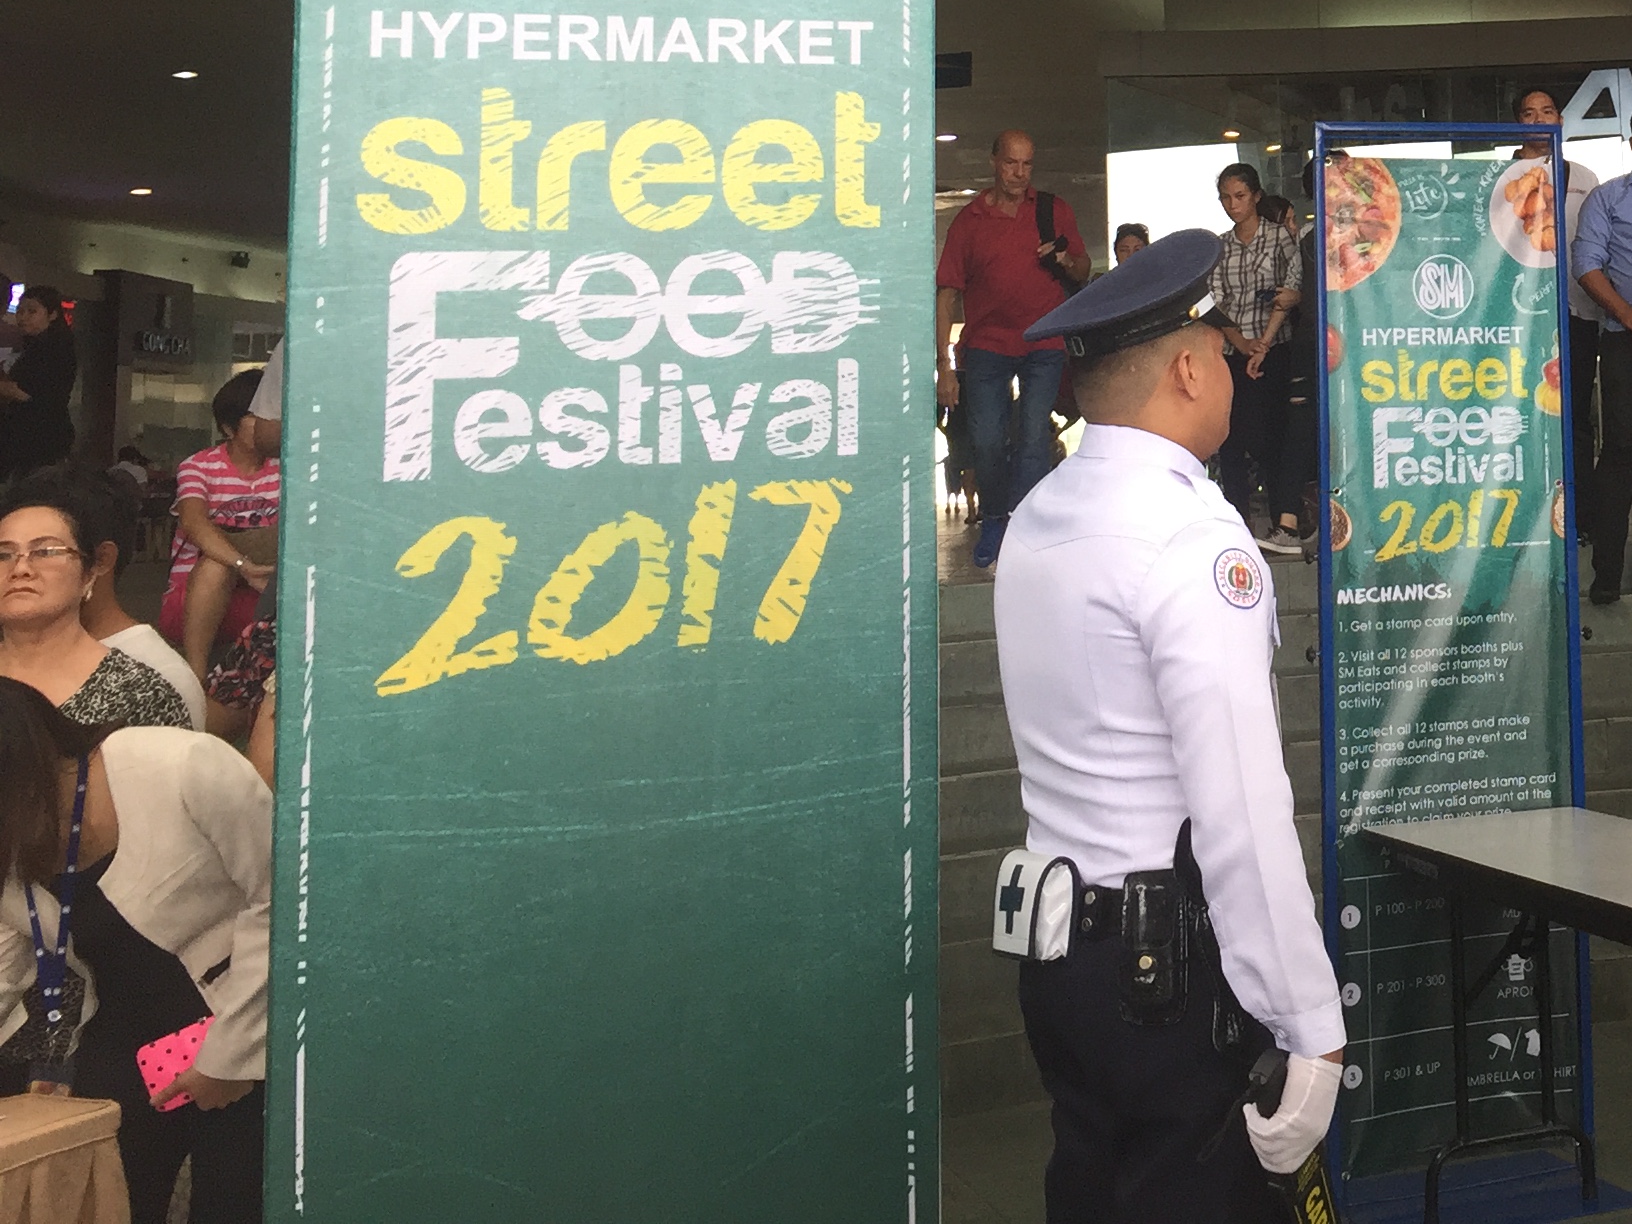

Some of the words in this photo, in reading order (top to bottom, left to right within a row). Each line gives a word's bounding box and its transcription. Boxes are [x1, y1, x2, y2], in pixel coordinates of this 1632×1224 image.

[369, 10, 874, 66] HYPERMARKET
[356, 87, 881, 233] street
[1419, 262, 1465, 311] SM
[1362, 326, 1524, 346] HYPERMARKET
[1361, 346, 1528, 403] street
[1374, 488, 1522, 563] 2017
[376, 476, 853, 697] 2017
[1338, 621, 1348, 633] 1.
[1350, 620, 1372, 632] Get
[1375, 622, 1384, 631] a
[1386, 617, 1421, 631] stamp
[1424, 615, 1453, 627] card
[1456, 614, 1483, 627] upon
[1351, 649, 1375, 662] Visit
[1377, 648, 1391, 661] all
[1394, 647, 1407, 659] 12
[1461, 641, 1498, 654] booths
[1501, 640, 1524, 653] plus
[1338, 666, 1355, 679] SM
[1357, 664, 1380, 677] Eats
[1383, 662, 1407, 675] and
[1409, 660, 1450, 673] collect
[1452, 657, 1491, 672] stamps
[1493, 656, 1508, 669] by
[1338, 679, 1414, 696] participating
[1416, 676, 1428, 688] in
[1431, 674, 1459, 687] each
[1461, 671, 1505, 685] booth's
[1352, 725, 1393, 739] Collect
[1397, 722, 1412, 735] all
[1415, 722, 1427, 734] 12
[1428, 719, 1469, 733] stamps
[1471, 716, 1495, 728] and
[1497, 714, 1530, 726] make
[1339, 746, 1348, 756] a
[1350, 741, 1404, 757] purchase
[1407, 737, 1442, 751] during
[1445, 734, 1464, 746] the
[1467, 731, 1501, 744] event
[1503, 729, 1527, 741] and
[1339, 759, 1359, 774] get
[1361, 759, 1370, 769] a
[1372, 751, 1455, 768] corresponding
[1352, 787, 1395, 801] Present
[1397, 785, 1422, 799] your
[1424, 777, 1488, 795] completed
[1490, 774, 1527, 789] stamp
[1529, 773, 1556, 785] card
[1339, 804, 1362, 818] and
[1365, 800, 1407, 816] receipt
[1409, 797, 1435, 810] with
[1438, 794, 1467, 807] valid
[1469, 791, 1514, 805] amount
[1517, 789, 1529, 801] at
[1532, 787, 1552, 799] the
[1375, 905, 1383, 916] P
[1386, 902, 1406, 916] 100
[1425, 896, 1445, 910] 200
[1347, 990, 1354, 1001] 2
[1376, 983, 1385, 995] P
[1387, 980, 1406, 993] 201
[1416, 978, 1423, 989] P
[1425, 974, 1446, 987] 300
[1350, 1071, 1357, 1082] 3
[1384, 1071, 1392, 1082] P
[1393, 1067, 1412, 1080] 301
[1415, 1064, 1424, 1077] &
[1426, 1061, 1441, 1075] UP
[1523, 1071, 1536, 1081] or
